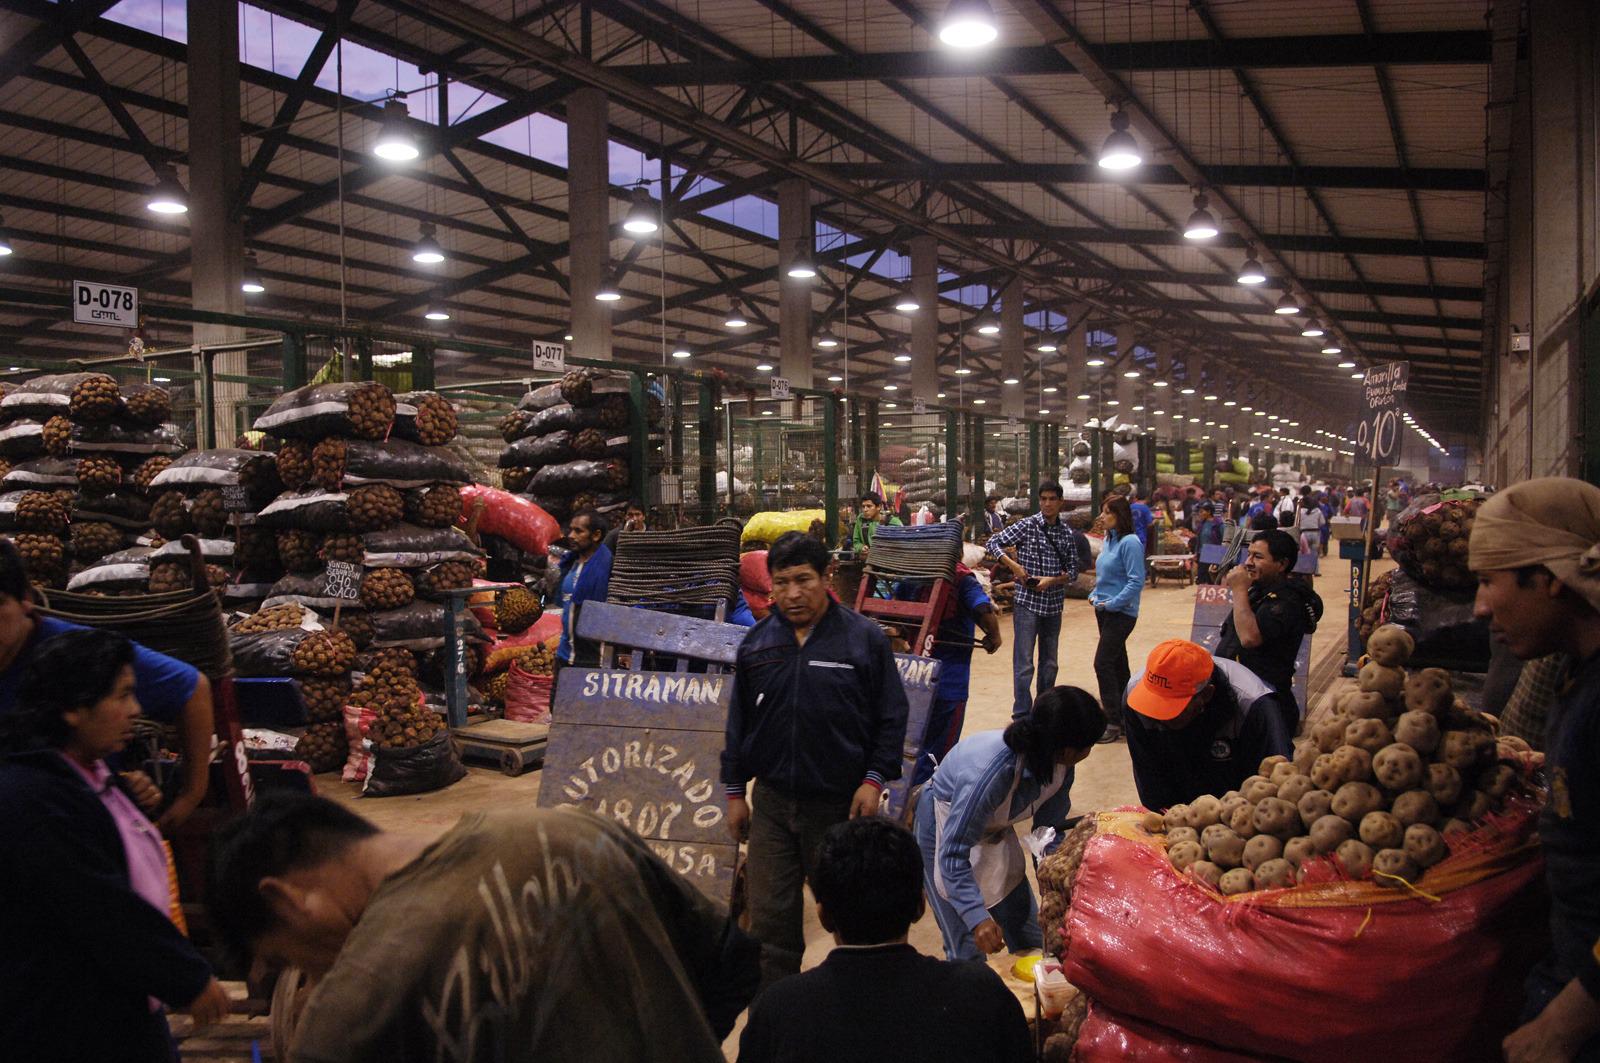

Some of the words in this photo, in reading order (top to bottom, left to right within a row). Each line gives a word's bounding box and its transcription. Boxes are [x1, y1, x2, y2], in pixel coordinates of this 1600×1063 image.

[78, 286, 134, 311] D-078
[535, 345, 562, 360] D-077
[583, 671, 723, 705] SITRAMAN
[562, 740, 723, 828] UTORIZADO
